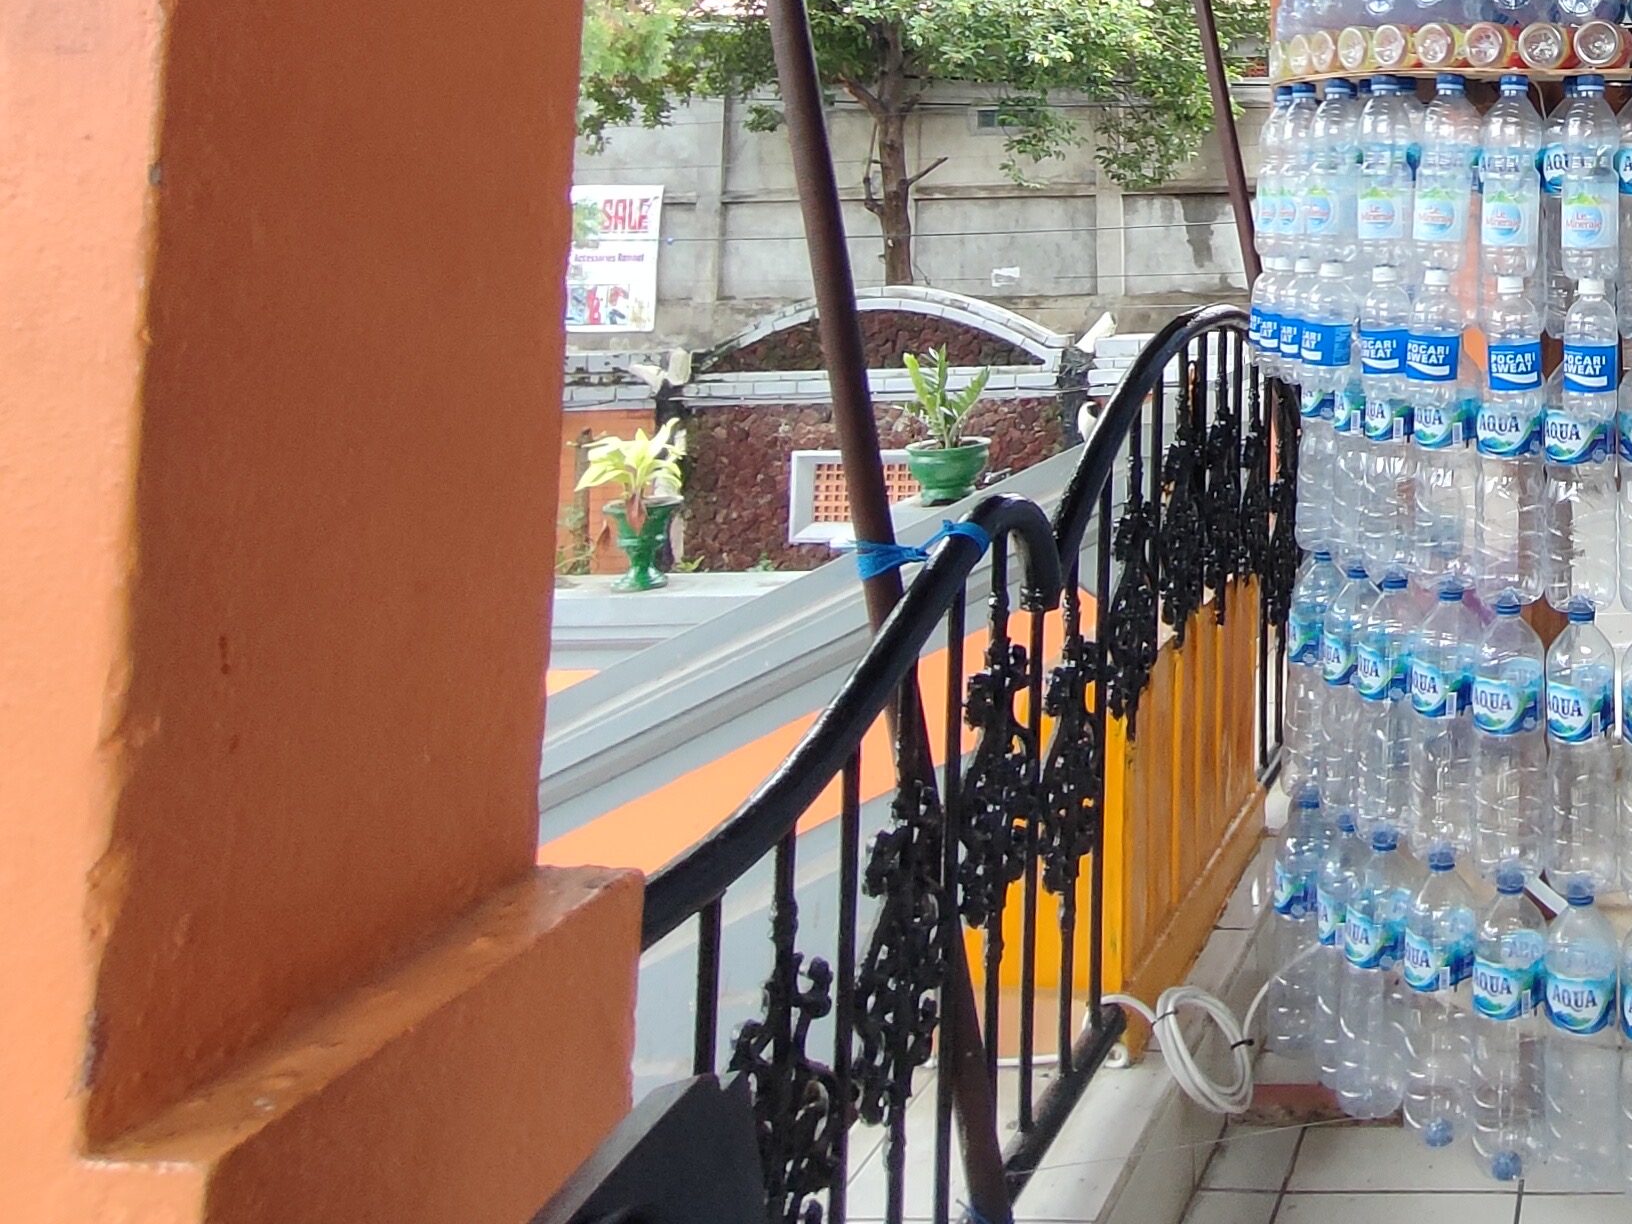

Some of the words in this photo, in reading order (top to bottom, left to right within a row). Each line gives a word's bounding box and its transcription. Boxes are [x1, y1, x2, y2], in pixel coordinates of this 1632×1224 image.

[602, 198, 650, 231] SALE
[1491, 352, 1535, 365] POCARI
[1564, 353, 1606, 366] POCARI
[1491, 362, 1532, 373] SWEAT
[1563, 363, 1602, 375] SWEAT
[1479, 413, 1521, 435] AQUA
[1412, 669, 1439, 695] QUA
[1552, 985, 1598, 1012] AQUA
